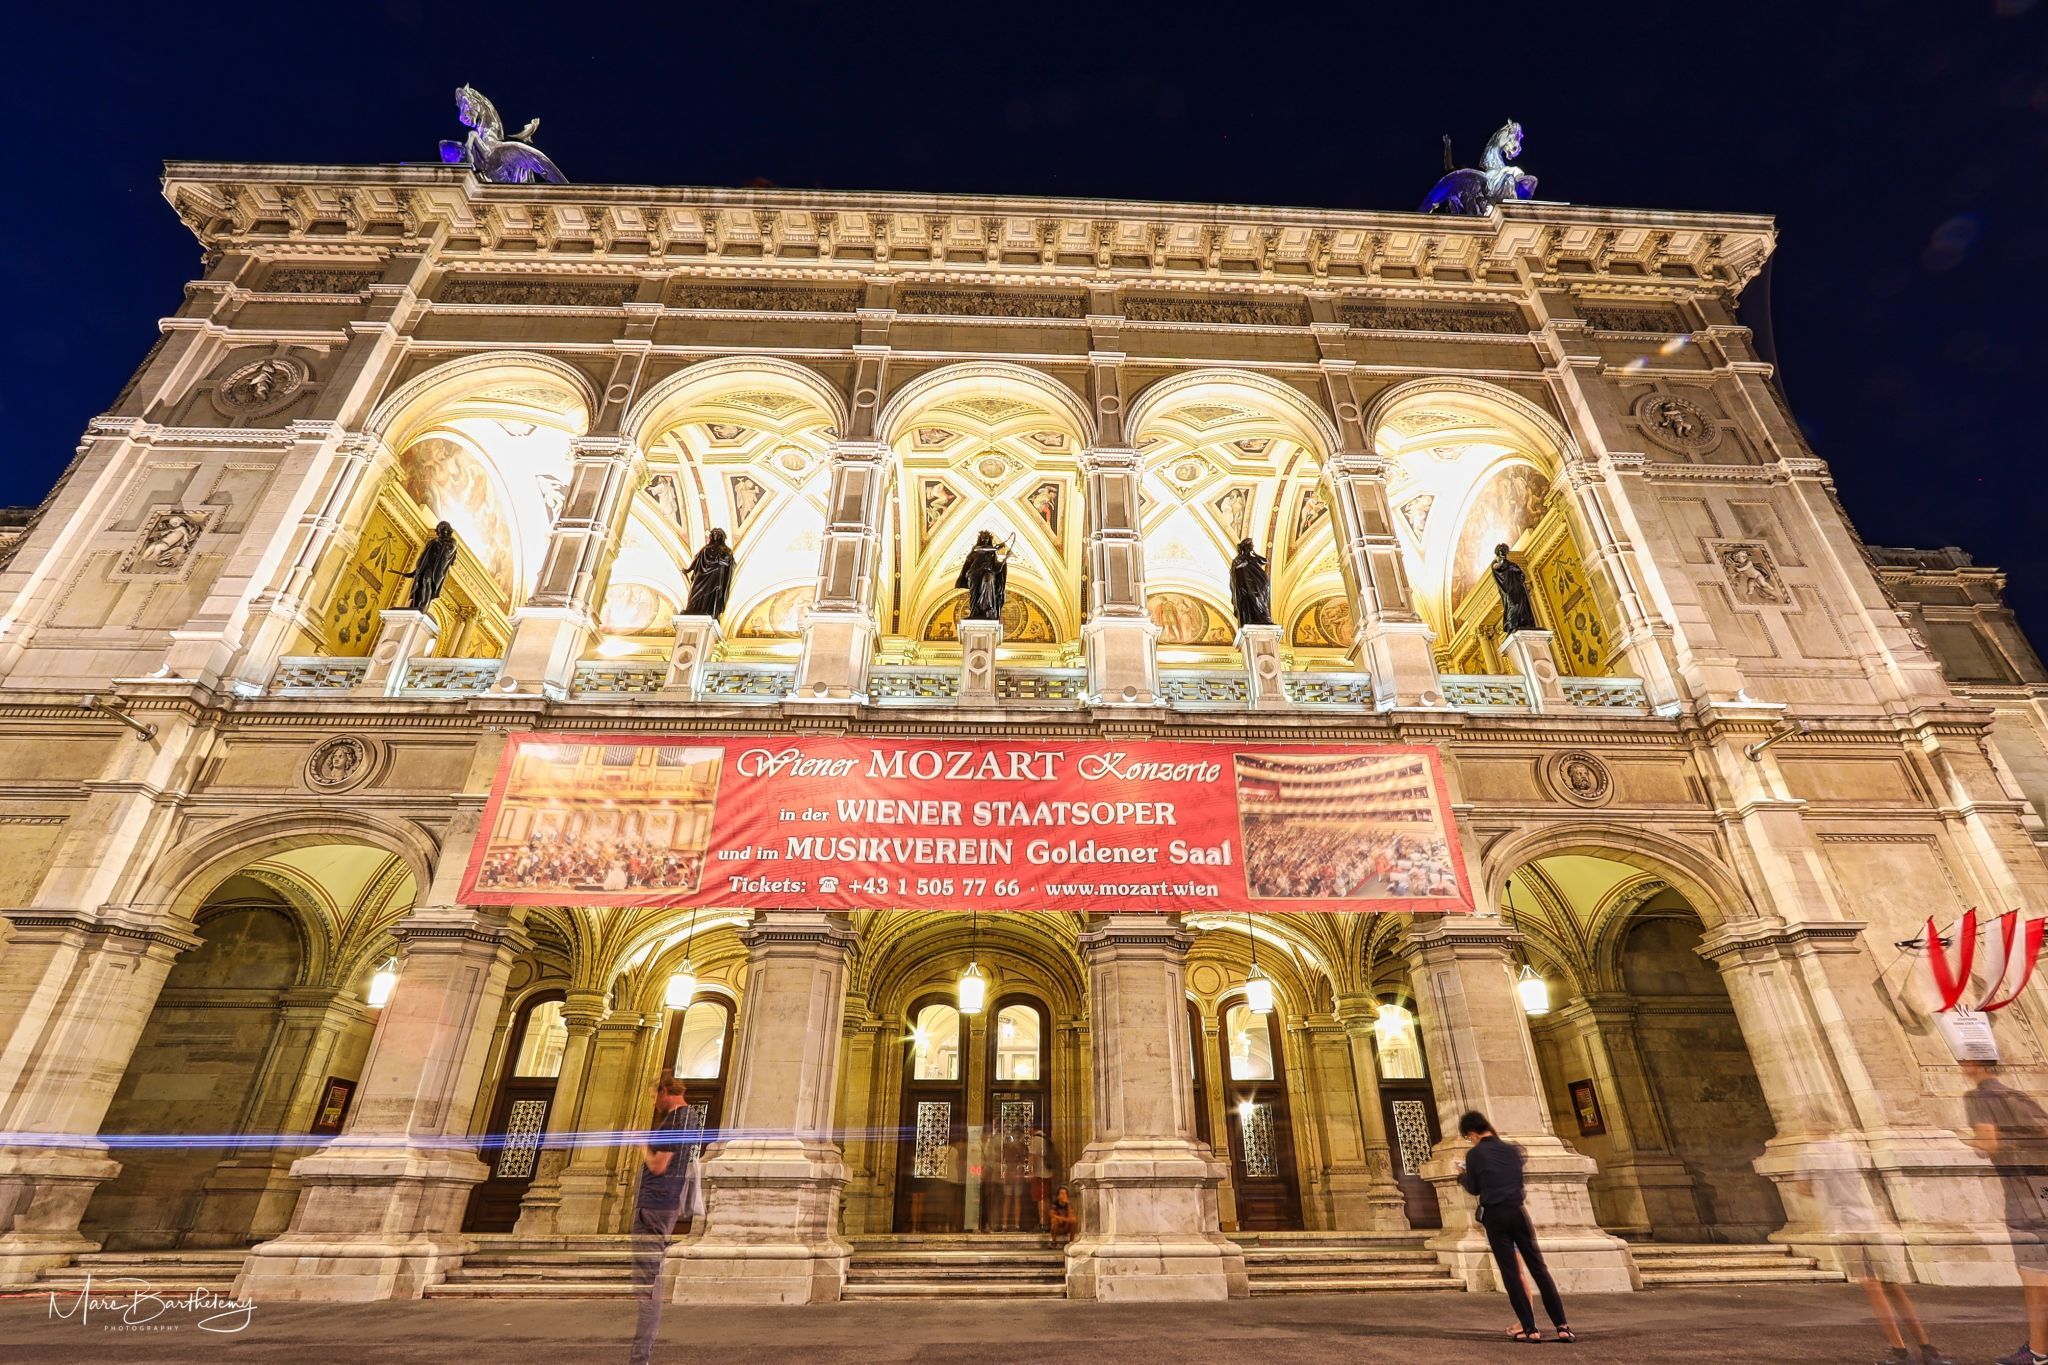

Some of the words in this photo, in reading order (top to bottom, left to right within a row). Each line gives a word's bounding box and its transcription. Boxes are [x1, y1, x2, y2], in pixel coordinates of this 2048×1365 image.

[736, 748, 859, 778] Wiener
[865, 750, 1065, 781] MOZART
[1077, 751, 1221, 783] Konzerte
[779, 808, 796, 822] in
[801, 807, 830, 822] der
[837, 799, 963, 826] WIENER
[972, 800, 1177, 827] STAATSOPER
[718, 846, 752, 861] und
[756, 846, 779, 860] im
[785, 836, 1013, 866] MUSIKVEREIN
[1025, 838, 1159, 865] Goldener
[1169, 839, 1233, 867] Saal
[728, 875, 807, 894] Tickets:
[848, 876, 889, 895] +43
[898, 878, 908, 896] 1
[916, 877, 954, 897] 505
[962, 878, 987, 897] 77
[994, 878, 1021, 897] 66
[1045, 880, 1220, 898] www.mozart.wien
